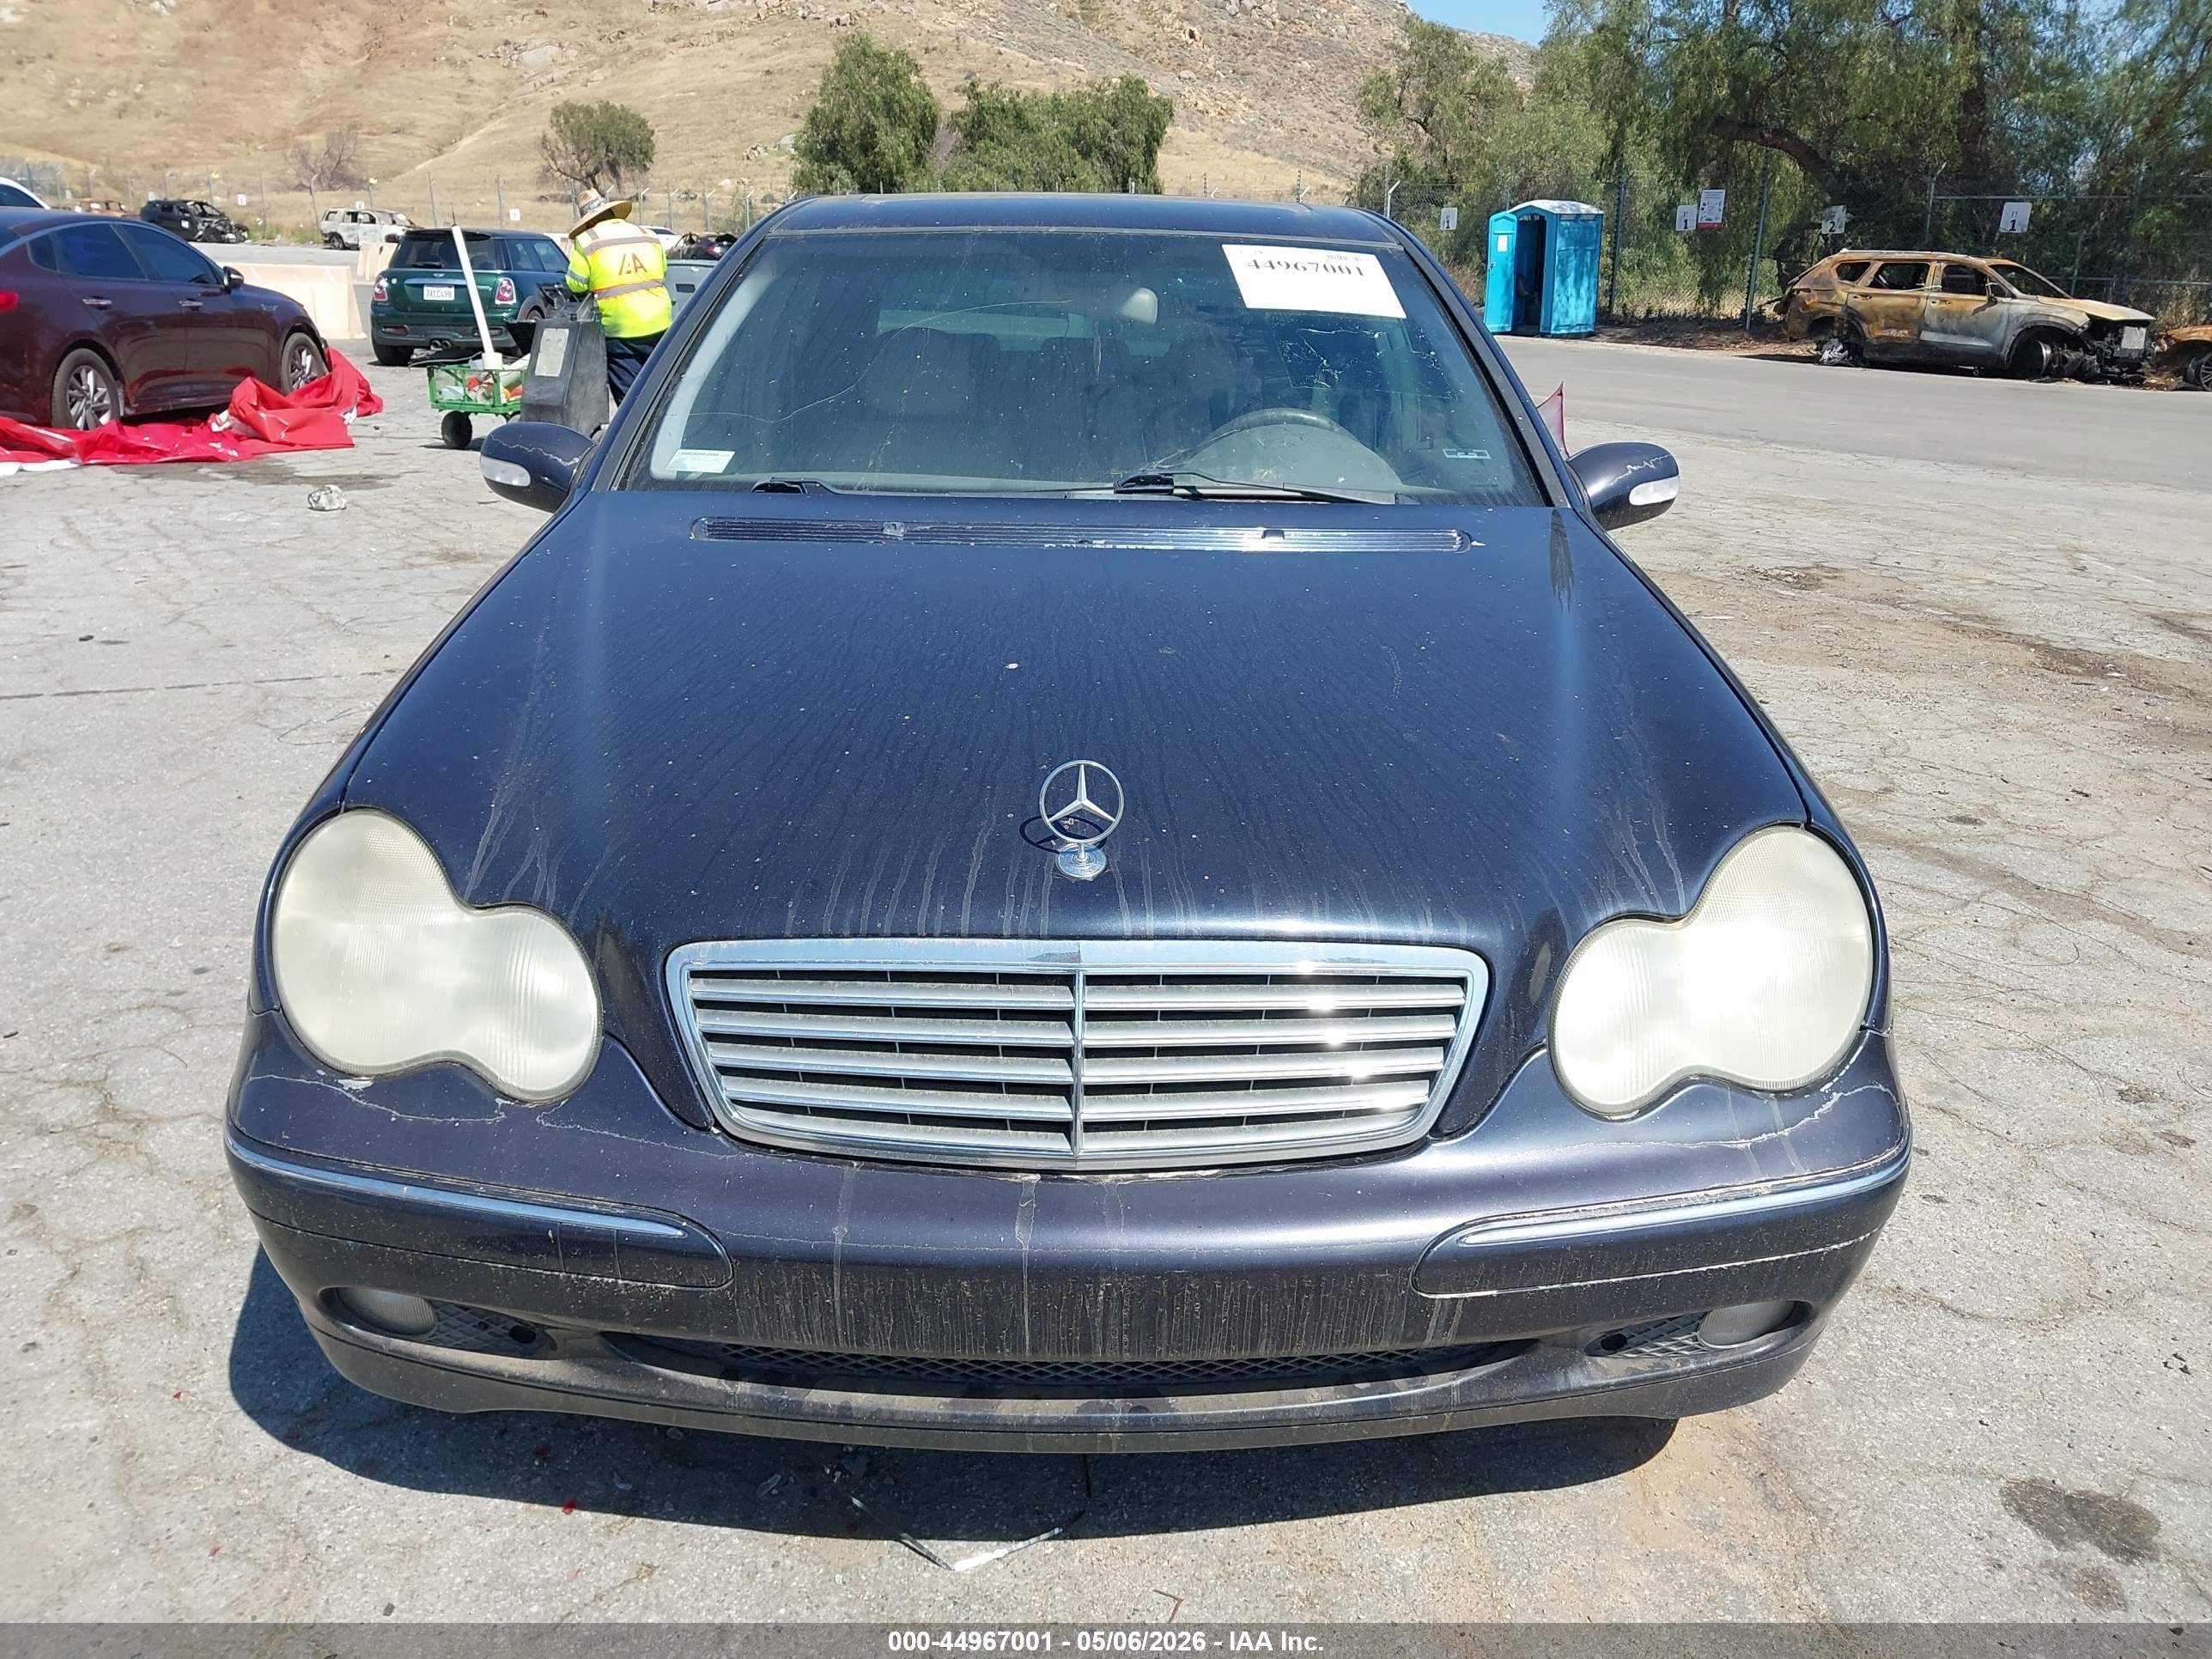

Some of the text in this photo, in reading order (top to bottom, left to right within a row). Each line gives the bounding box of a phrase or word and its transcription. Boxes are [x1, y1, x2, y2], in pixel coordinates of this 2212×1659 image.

[1683, 219, 1689, 229] 1
[1829, 221, 1836, 233] 2
[2009, 219, 2017, 231] 1
[1246, 258, 1364, 276] 44967001
